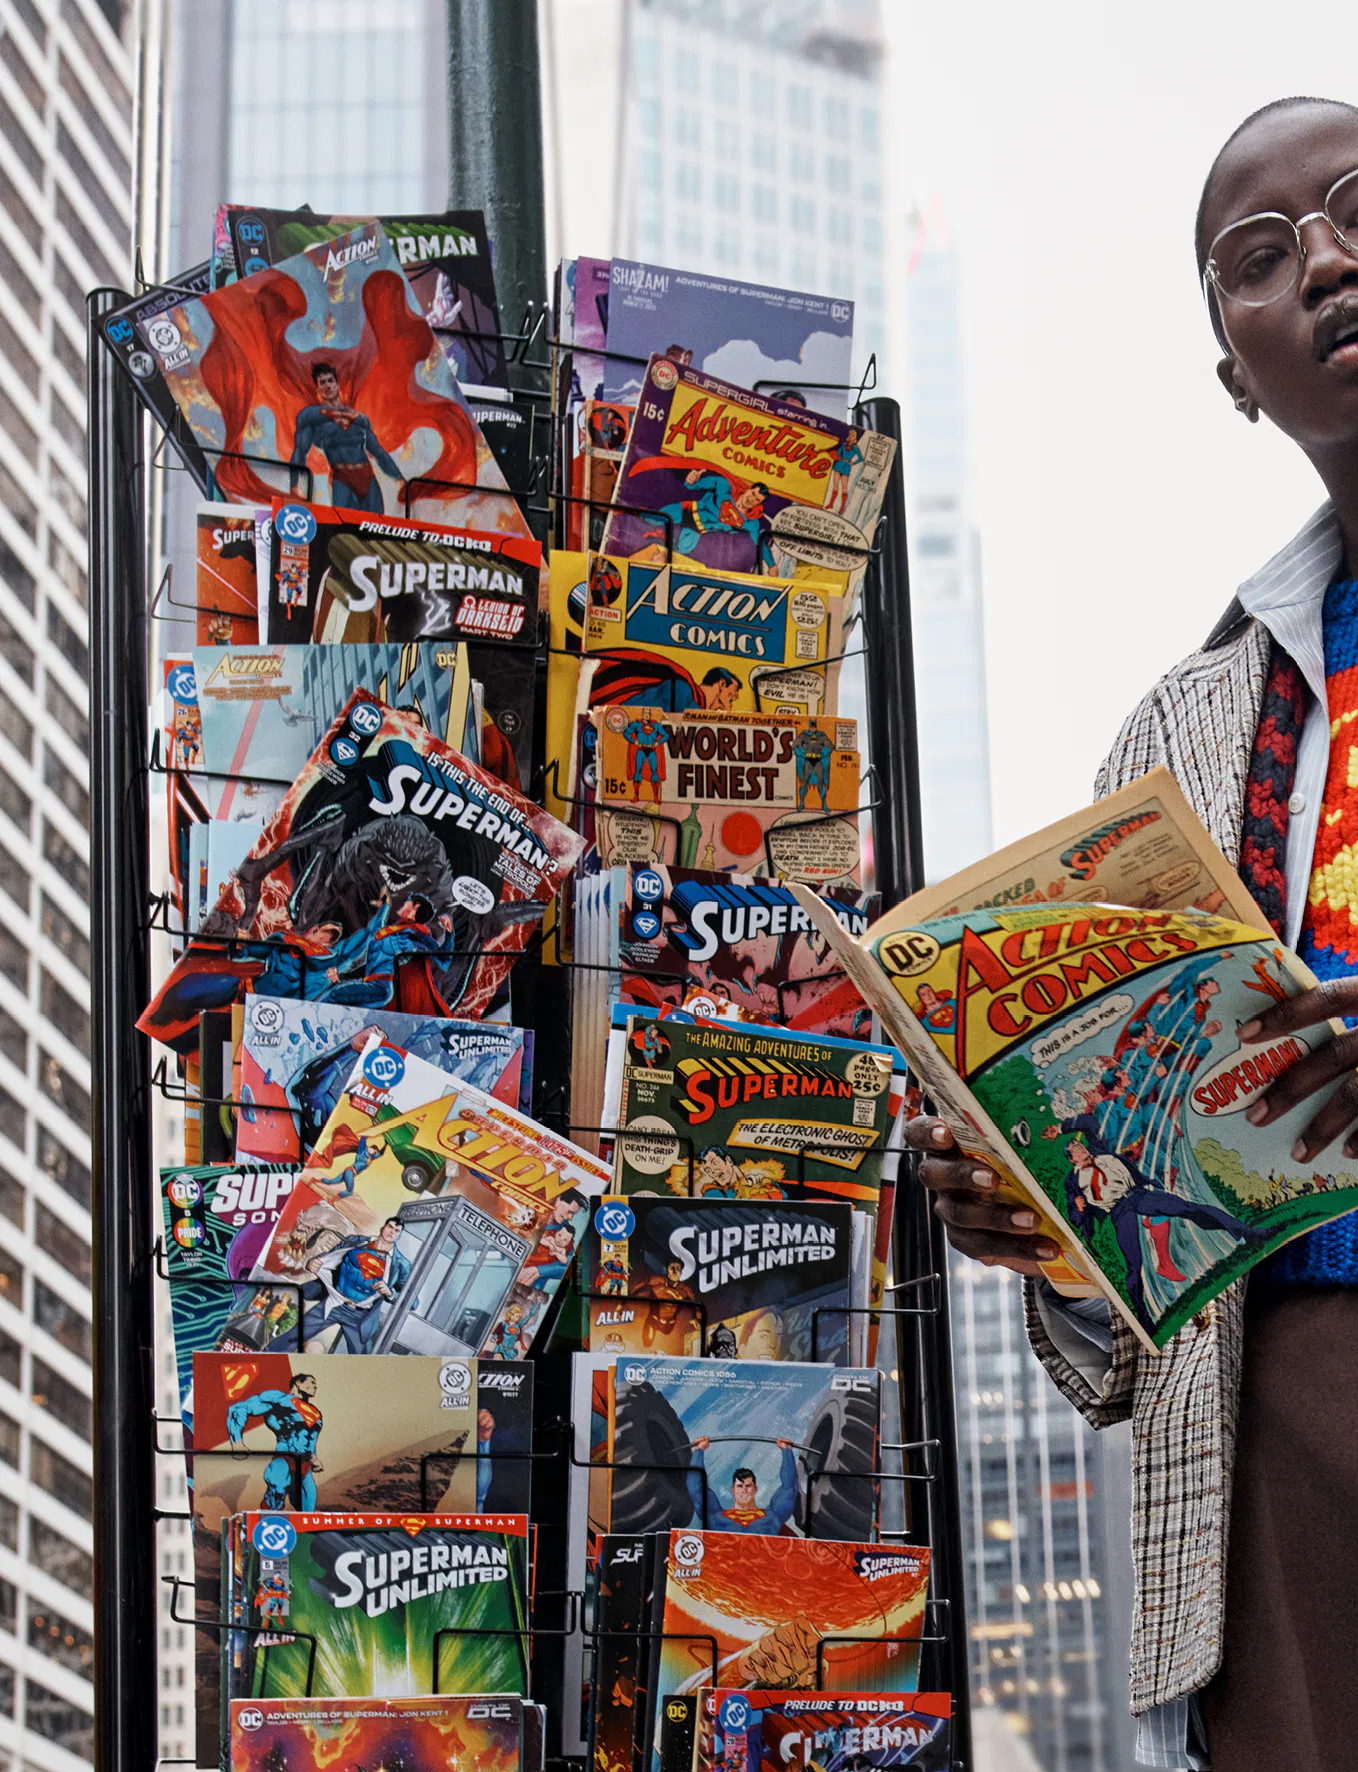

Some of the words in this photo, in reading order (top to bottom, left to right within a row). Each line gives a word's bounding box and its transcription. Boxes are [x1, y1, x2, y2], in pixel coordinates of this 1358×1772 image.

[238, 222, 265, 241] DC
[323, 236, 378, 284] ACTION
[613, 266, 669, 293] SHAZAM!
[675, 276, 727, 292] ADVENTURES
[831, 305, 850, 319] DC
[106, 320, 135, 344] DC
[164, 353, 180, 371] ALL
[178, 347, 189, 364] IN
[684, 370, 774, 415] SUPERGIRL
[776, 407, 819, 429] starring
[642, 401, 666, 423] 15¢
[665, 398, 832, 480] Adventure
[722, 446, 786, 479] COMICS
[285, 516, 307, 534] DC
[359, 521, 420, 540] PRELUDE
[422, 531, 441, 543] TO
[212, 528, 255, 550] SUPER
[839, 531, 862, 543] THAT
[779, 540, 797, 551] OFF
[798, 547, 824, 560] LIMITS
[348, 554, 523, 612] SUPERMAN
[626, 564, 794, 623] ACTION
[455, 607, 525, 634] DARKSEID
[588, 606, 619, 619] ACTION
[460, 626, 488, 637] PART
[489, 631, 513, 640] TWO
[670, 622, 765, 657] COMICS
[436, 652, 457, 665] DC
[204, 652, 286, 686] ACTION
[762, 674, 818, 689] SUPERMAN!
[763, 688, 786, 699] EVIL
[351, 704, 382, 734] DC
[718, 713, 750, 723] BATMAN
[752, 716, 794, 726] TOGETHER
[348, 730, 363, 744] 32
[661, 723, 794, 764] WORLD'S
[426, 751, 442, 769] IS
[439, 758, 466, 786] THIS
[465, 773, 489, 801] THE
[487, 788, 510, 815] END
[604, 778, 627, 795] 15¢
[678, 763, 779, 801] FINEST
[498, 854, 528, 879] TALES
[525, 874, 541, 887] OF
[803, 866, 821, 874] RED
[637, 877, 661, 894] DC
[688, 899, 868, 962] SUPERAN
[885, 936, 934, 972] DC
[987, 929, 1199, 1037] COMICS
[954, 912, 1176, 1081] ACTION
[251, 1035, 269, 1046] ALL
[269, 1034, 282, 1045] IN
[449, 1033, 513, 1055] SUPERMAN
[686, 1032, 702, 1045] THE
[702, 1031, 752, 1053] AMAZING
[753, 1039, 820, 1063] ADVENTURES
[821, 1050, 833, 1061] OF
[1040, 1039, 1061, 1058] THIS
[1061, 1034, 1071, 1044] IS
[1080, 1017, 1098, 1032] JOB
[459, 1045, 513, 1061] UNLIMITED
[374, 1058, 396, 1077] DC
[637, 1070, 673, 1082] SUPERMAN
[854, 1072, 880, 1082] ONLY
[351, 1081, 377, 1101] ALL
[375, 1091, 394, 1106] IN
[636, 1088, 656, 1098] NOV.
[852, 1080, 882, 1094] 25¢
[686, 1070, 854, 1126] SUPERMAN
[738, 1123, 758, 1134] THE
[758, 1122, 834, 1141] ELECTRONIC
[833, 1130, 874, 1148] GHOST
[753, 1135, 770, 1146] OF
[357, 1091, 581, 1203] ACTION
[624, 1142, 675, 1156] DEATH-GRIP
[635, 1151, 648, 1163] ON
[648, 1152, 666, 1166] ME!
[173, 1180, 200, 1201] DC
[490, 1180, 550, 1215] COMICS
[605, 1213, 626, 1231] DC
[177, 1227, 202, 1240] PRIDE
[458, 1207, 526, 1259] TELEPHONE
[669, 1223, 836, 1282] SUPERMAN
[699, 1246, 836, 1294] UNLIMITED
[596, 1312, 621, 1326] ALL
[621, 1310, 635, 1322] IN
[479, 1374, 525, 1388] CTION
[626, 1367, 646, 1381] DC
[650, 1367, 681, 1376] ACTION
[682, 1369, 715, 1378] COMICS
[830, 1379, 872, 1392] DC
[441, 1397, 459, 1409] ALL
[459, 1396, 470, 1407] IN
[303, 1517, 365, 1526] SUMMER
[375, 1517, 393, 1526] OF
[435, 1518, 516, 1526] SUPERMAN
[263, 1527, 286, 1547] DC
[681, 1543, 698, 1559] DC
[674, 1568, 691, 1579] ALL
[690, 1568, 702, 1577] IN
[860, 1556, 920, 1577] SUPERMAN
[869, 1567, 919, 1582] UNLIMITED
[334, 1545, 507, 1609] SUPERMAN
[366, 1566, 509, 1619] UNLIMITED
[254, 1632, 281, 1648] ALL
[467, 1707, 512, 1719] DC
[667, 1705, 688, 1719] DC
[728, 1705, 746, 1723] DC
[784, 1699, 835, 1711] PRELUDE
[836, 1699, 856, 1711] TO
[240, 1711, 263, 1728] DC
[267, 1711, 329, 1720] ADVENTURES
[329, 1711, 343, 1719] OF
[399, 1710, 417, 1718] JON
[418, 1710, 443, 1718] KENT
